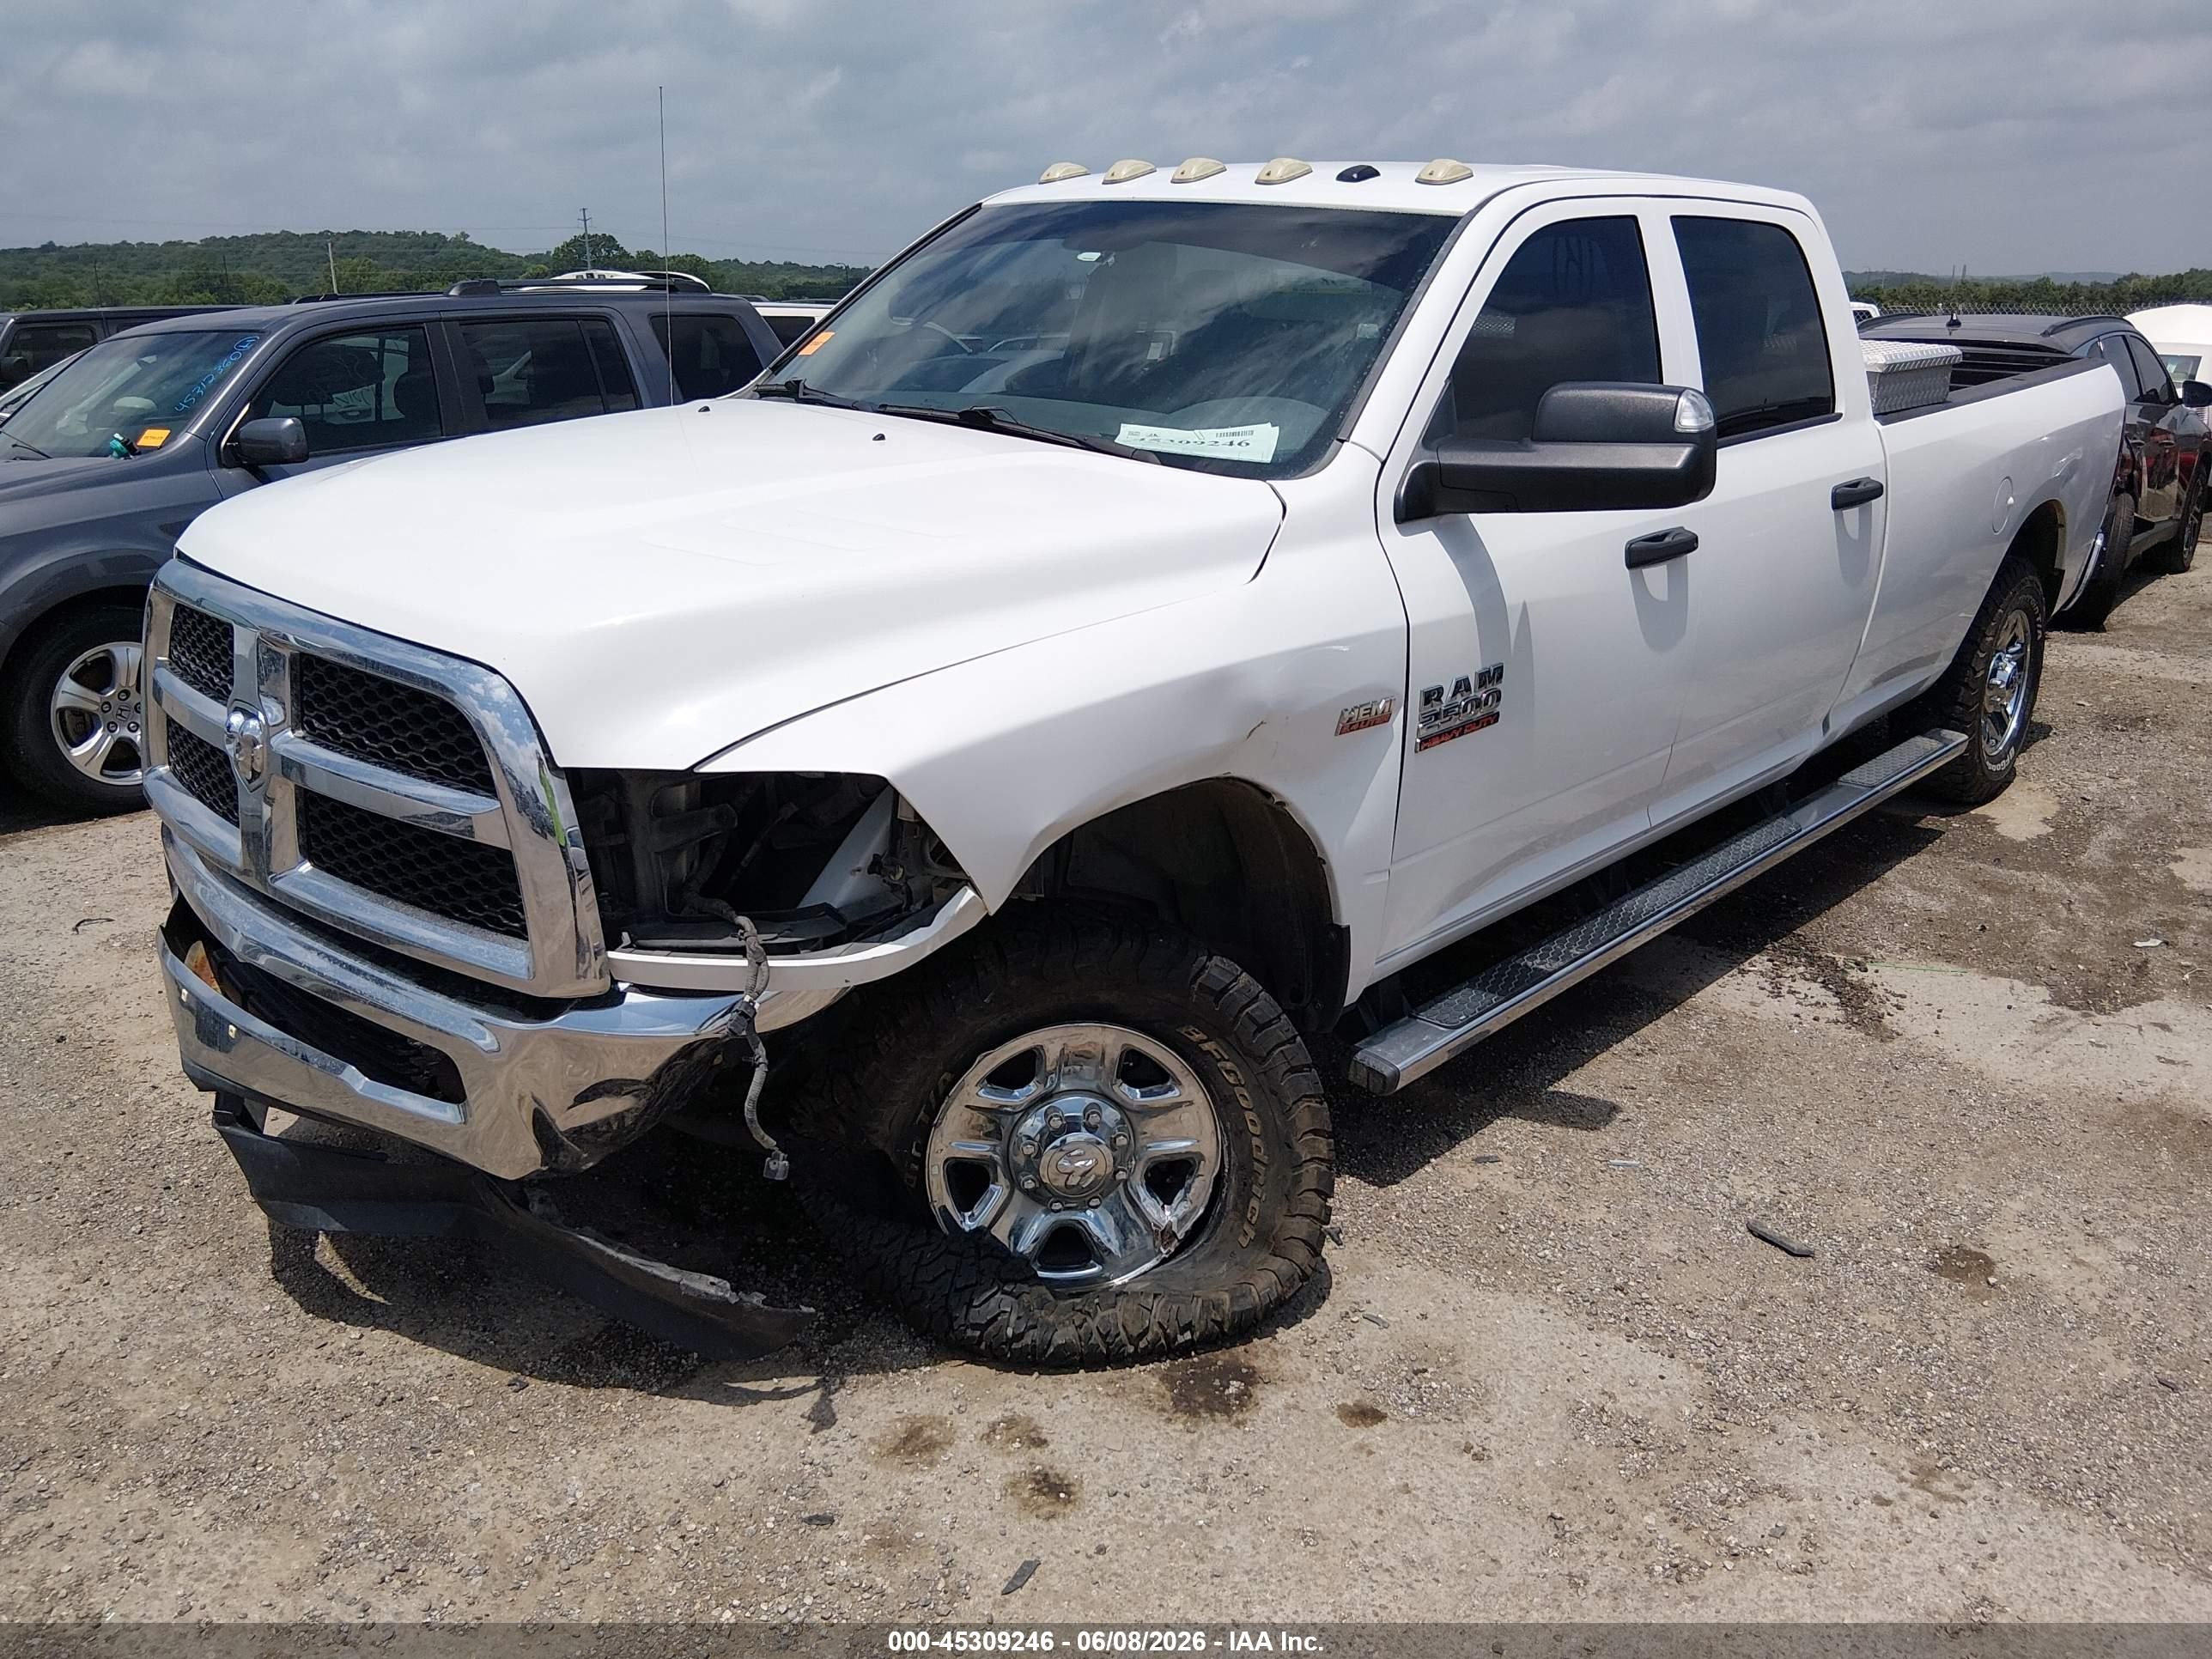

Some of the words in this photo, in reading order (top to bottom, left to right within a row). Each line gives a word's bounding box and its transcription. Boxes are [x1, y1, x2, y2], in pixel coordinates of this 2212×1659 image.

[1419, 662, 1504, 708] RAM
[1337, 696, 1395, 726] HEMI
[1419, 688, 1502, 729] 2500
[1178, 1025, 1268, 1248] BFGoodrich
